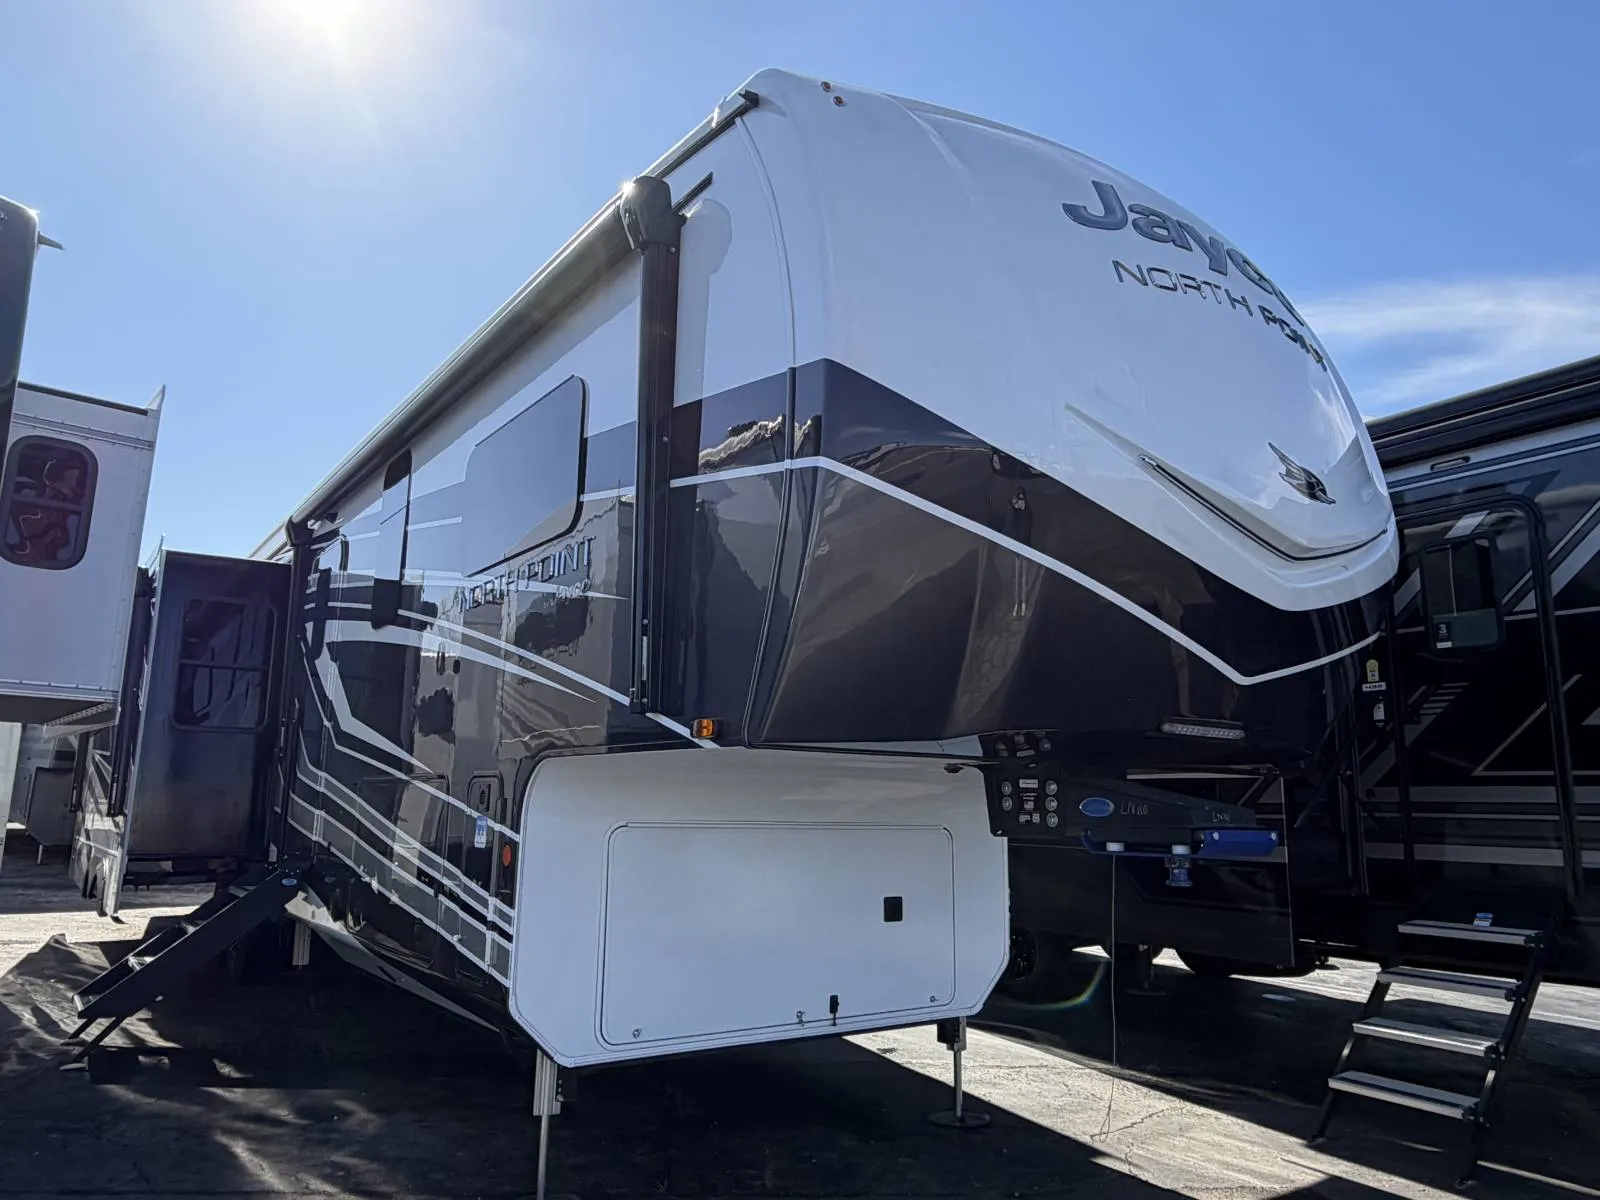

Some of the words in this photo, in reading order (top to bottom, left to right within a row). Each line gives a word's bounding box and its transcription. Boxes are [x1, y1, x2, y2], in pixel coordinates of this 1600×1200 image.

[1111, 260, 1253, 316] NORTH
[458, 568, 520, 614] NORTH
[525, 535, 597, 589] POINT
[1439, 624, 1447, 633] 3
